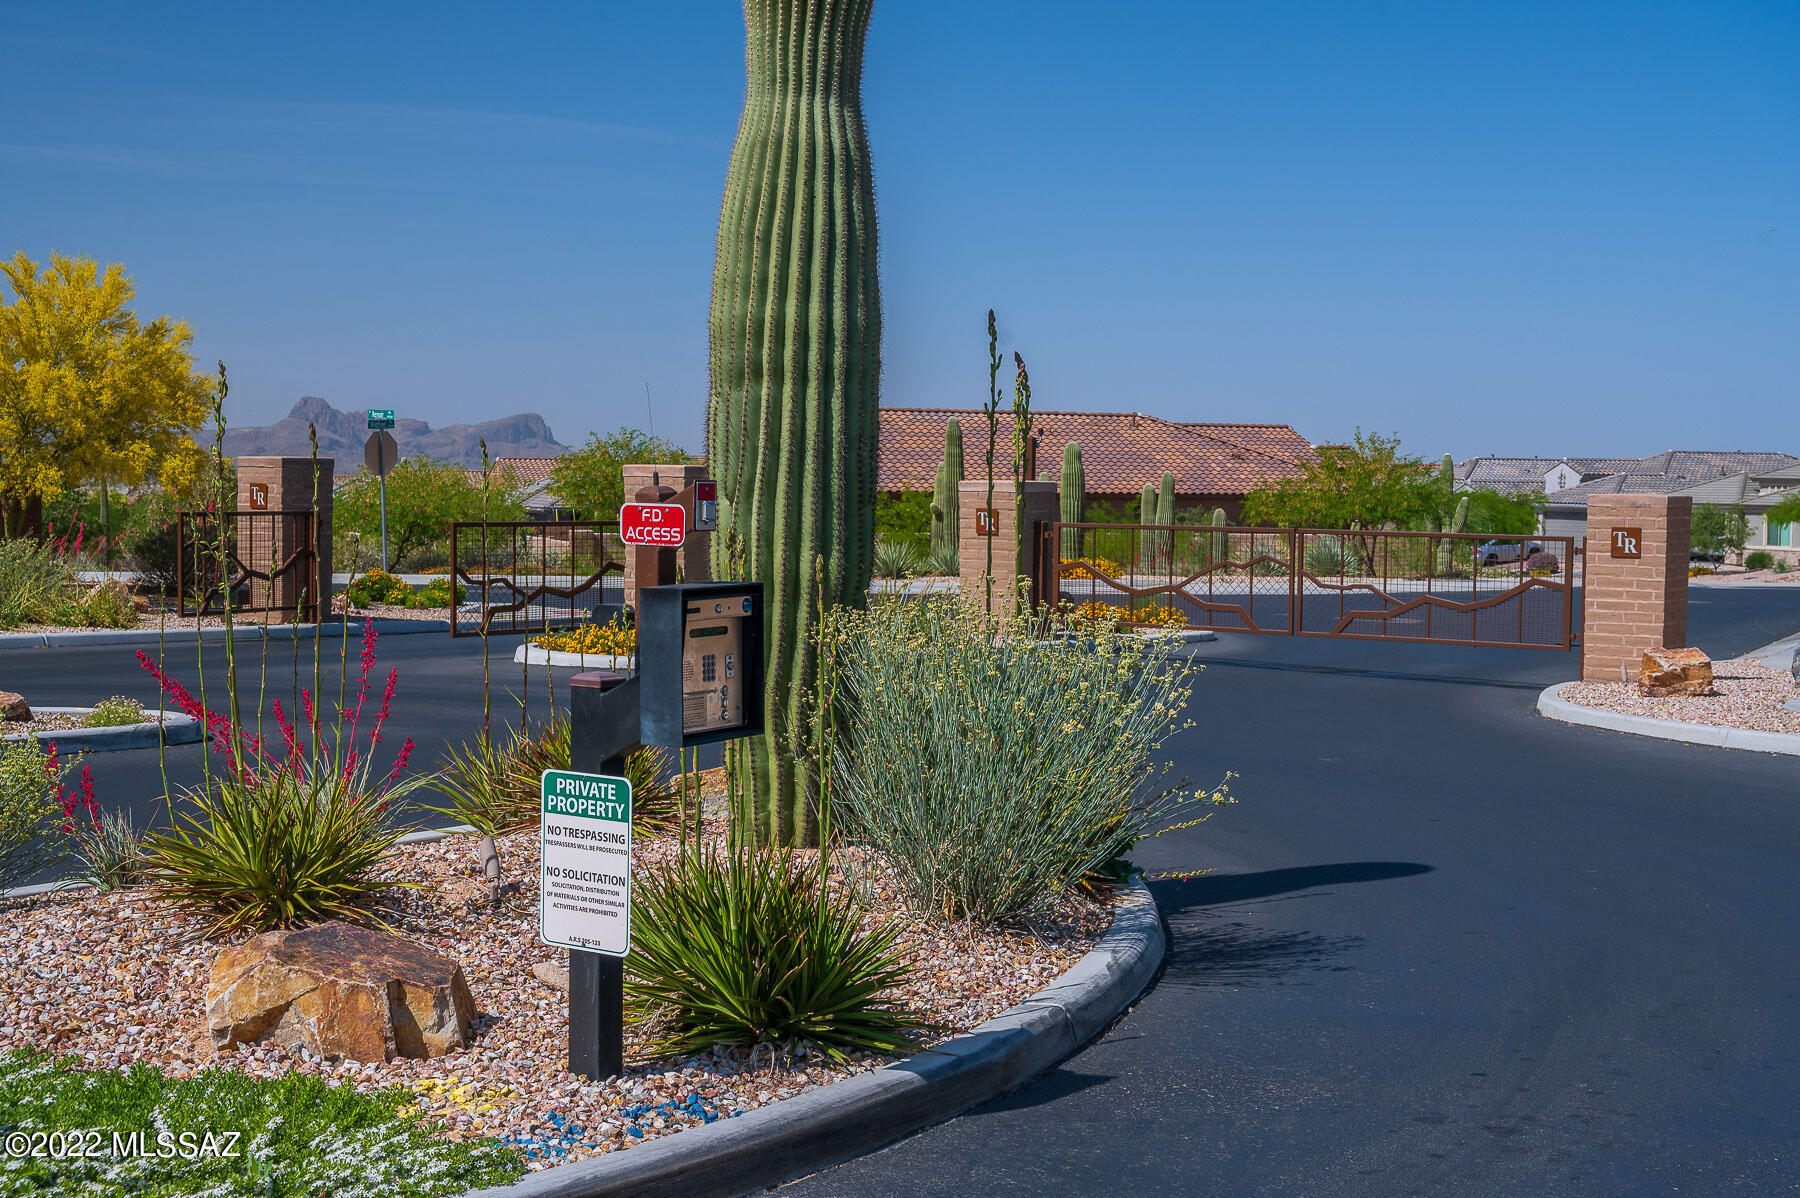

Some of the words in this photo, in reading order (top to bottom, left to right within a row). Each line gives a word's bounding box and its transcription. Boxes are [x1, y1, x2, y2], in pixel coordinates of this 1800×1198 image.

[641, 508, 664, 522] F.D.
[625, 526, 681, 541] ACCESS
[556, 777, 617, 800] PRIVATE
[547, 794, 625, 819] PROPERTY
[547, 825, 561, 836] NO
[563, 827, 626, 845] TRESPASSING
[545, 840, 577, 849] TRESPASSERS
[577, 843, 589, 851] WILL
[596, 846, 628, 856] PROSECUTED
[546, 866, 561, 877] NO
[562, 868, 626, 887] SOLICITATION
[586, 886, 620, 897] DISTRIBUTION
[554, 892, 580, 901] MATERIALS
[588, 897, 604, 905] OTHER
[605, 900, 625, 908] SIMILAR
[552, 902, 578, 912] ACTIVITIES
[589, 907, 618, 918] PROHIBITED
